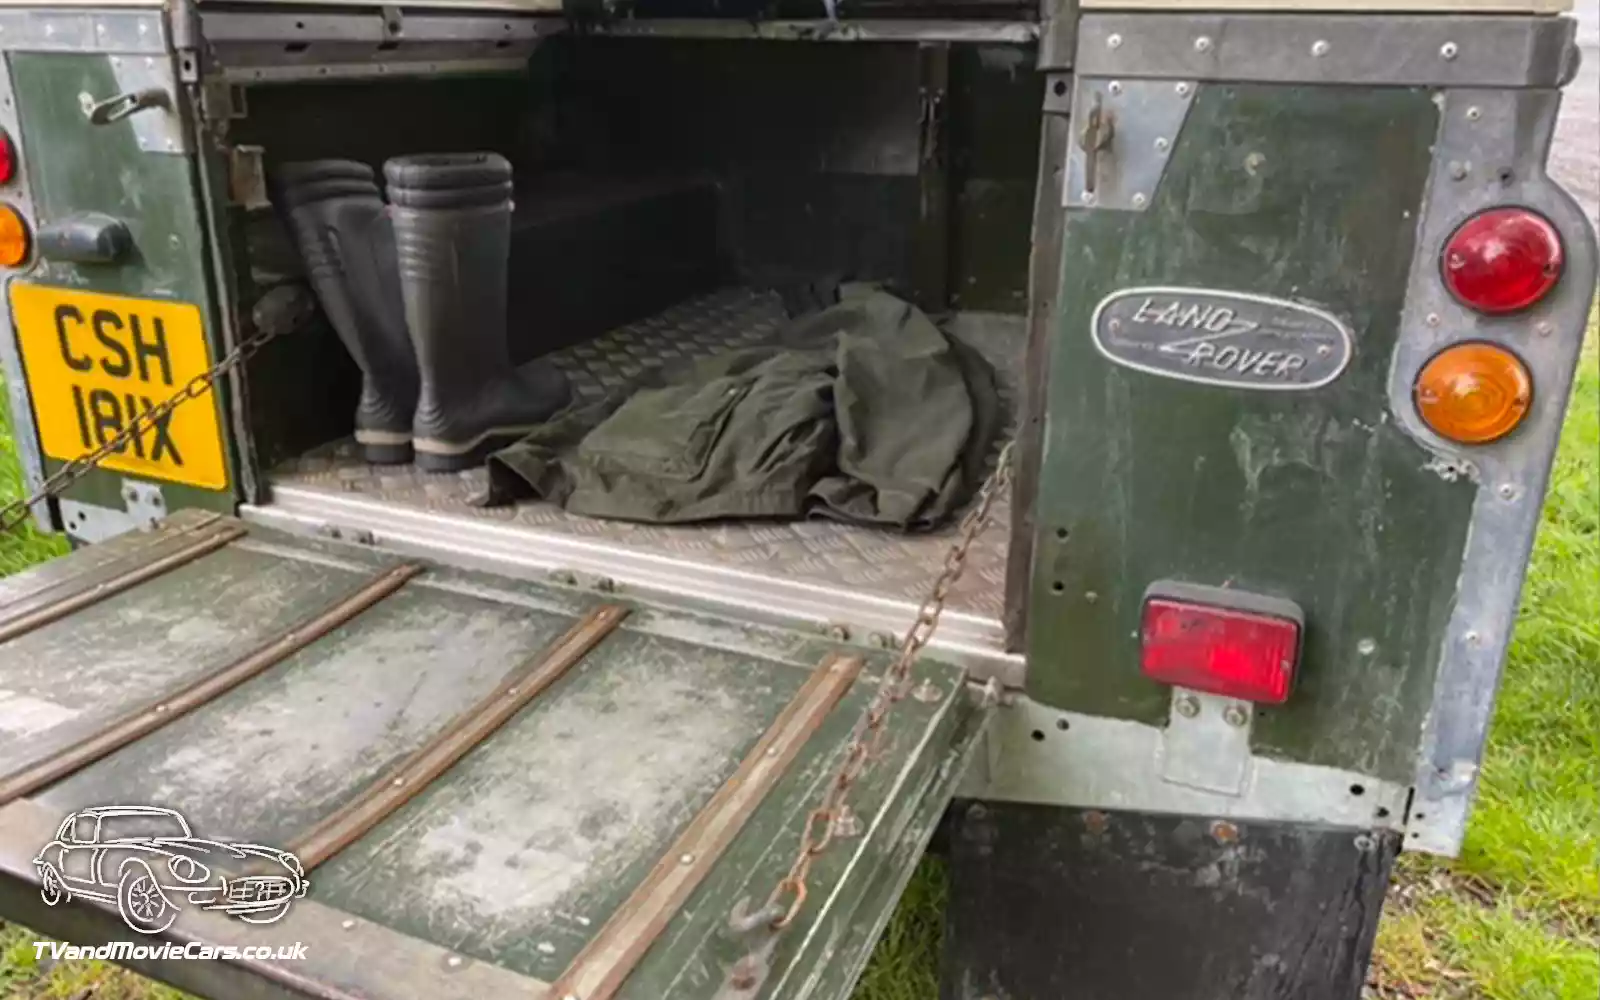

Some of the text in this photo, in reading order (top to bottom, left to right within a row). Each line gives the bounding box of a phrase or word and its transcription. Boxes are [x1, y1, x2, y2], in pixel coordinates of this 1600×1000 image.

[54, 303, 174, 386] CSH
[1131, 298, 1236, 332] LAND
[1187, 342, 1307, 379] ROVER
[71, 383, 185, 467] 181X
